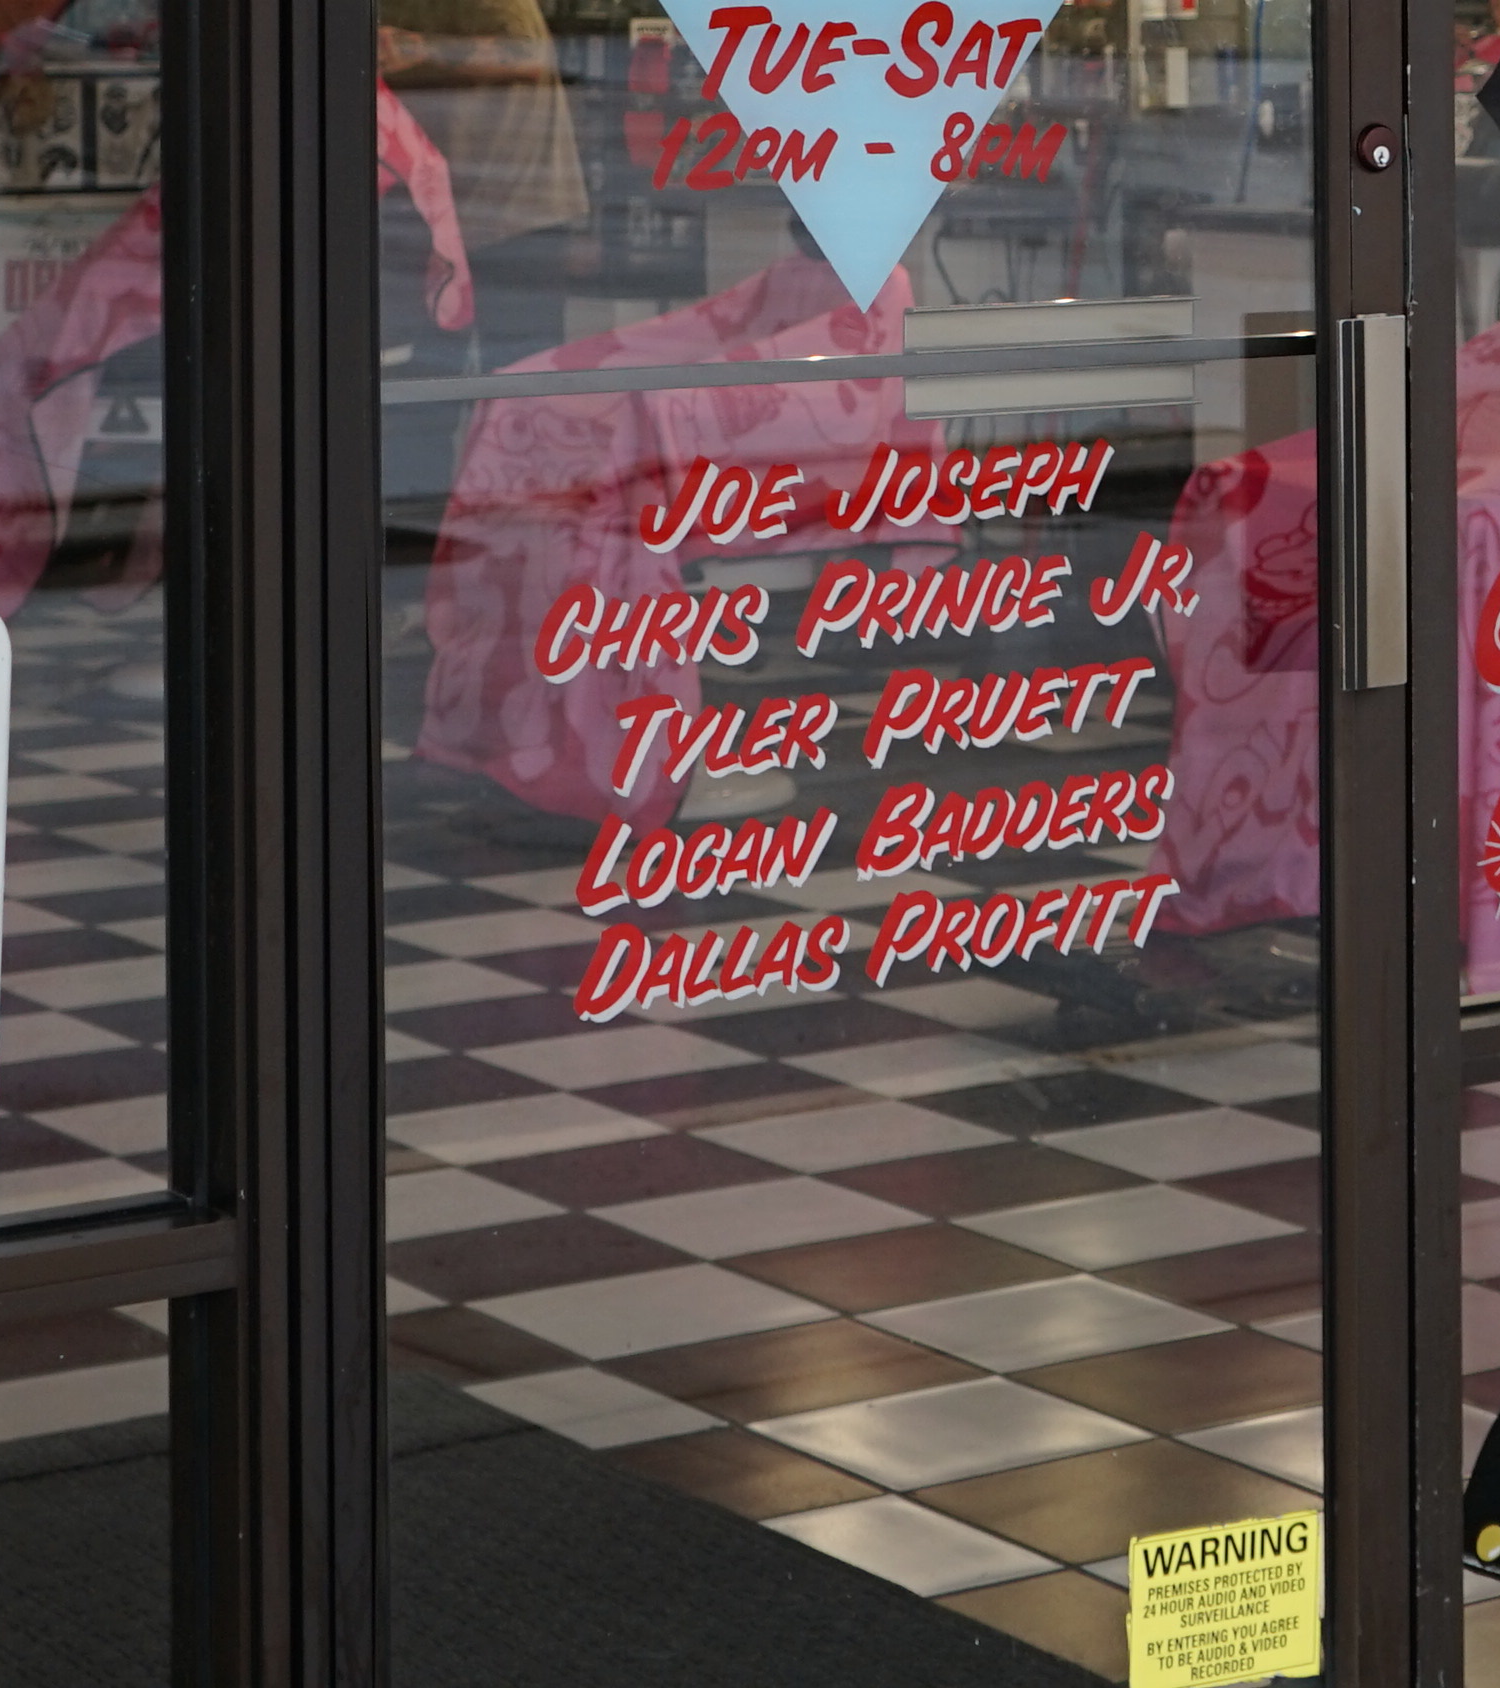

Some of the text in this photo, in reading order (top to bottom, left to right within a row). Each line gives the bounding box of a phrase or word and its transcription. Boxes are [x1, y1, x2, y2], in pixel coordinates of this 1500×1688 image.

[700, 0, 1042, 102] TUE-SAT
[653, 115, 839, 192] 12PM
[930, 110, 1069, 184] 8PM
[640, 438, 1115, 554] JOE JOSEPH
[534, 530, 1201, 685] CHRIS PRINCE JR.
[611, 657, 1156, 799] TYLER PRUETT
[575, 806, 838, 917] LOGAN
[856, 763, 1175, 884] BADDERS
[573, 874, 1180, 1025] DALLAS PROFITT
[1143, 1521, 1309, 1579] WARNING
[1147, 1562, 1304, 1602] PREMISES PROTECTED BY
[1143, 1577, 1306, 1619] 24 HOUR AUDIO AND VIDEO
[1180, 1599, 1271, 1629] SURVEILLANCE
[1147, 1615, 1300, 1658] BY ENTERING YOU AGREE
[1158, 1634, 1288, 1671] TO BE AUDIO & VIDEO
[1190, 1657, 1255, 1683] RECORDED
